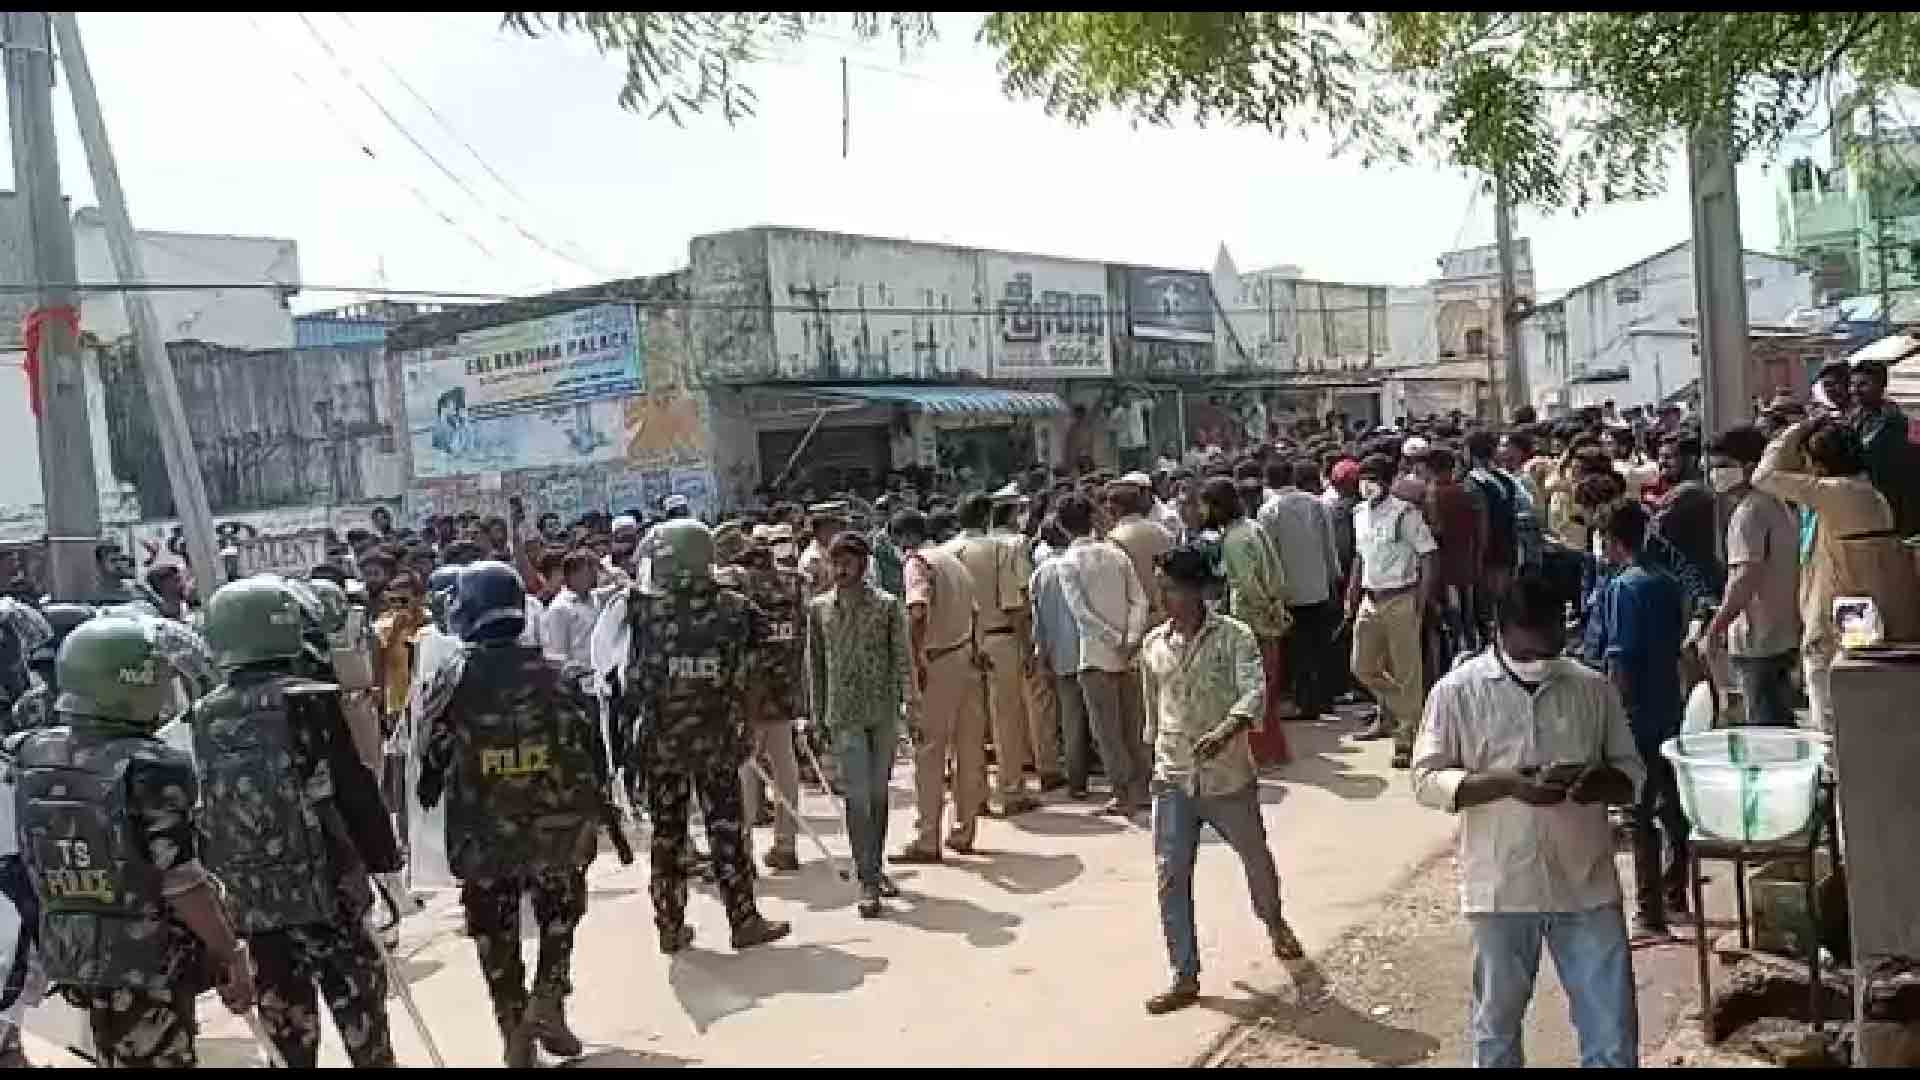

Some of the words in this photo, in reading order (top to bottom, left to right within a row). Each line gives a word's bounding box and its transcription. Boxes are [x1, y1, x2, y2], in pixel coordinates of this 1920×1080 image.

[245, 539, 319, 570] TALENT
[668, 656, 720, 678] POLICE
[56, 839, 90, 868] TS
